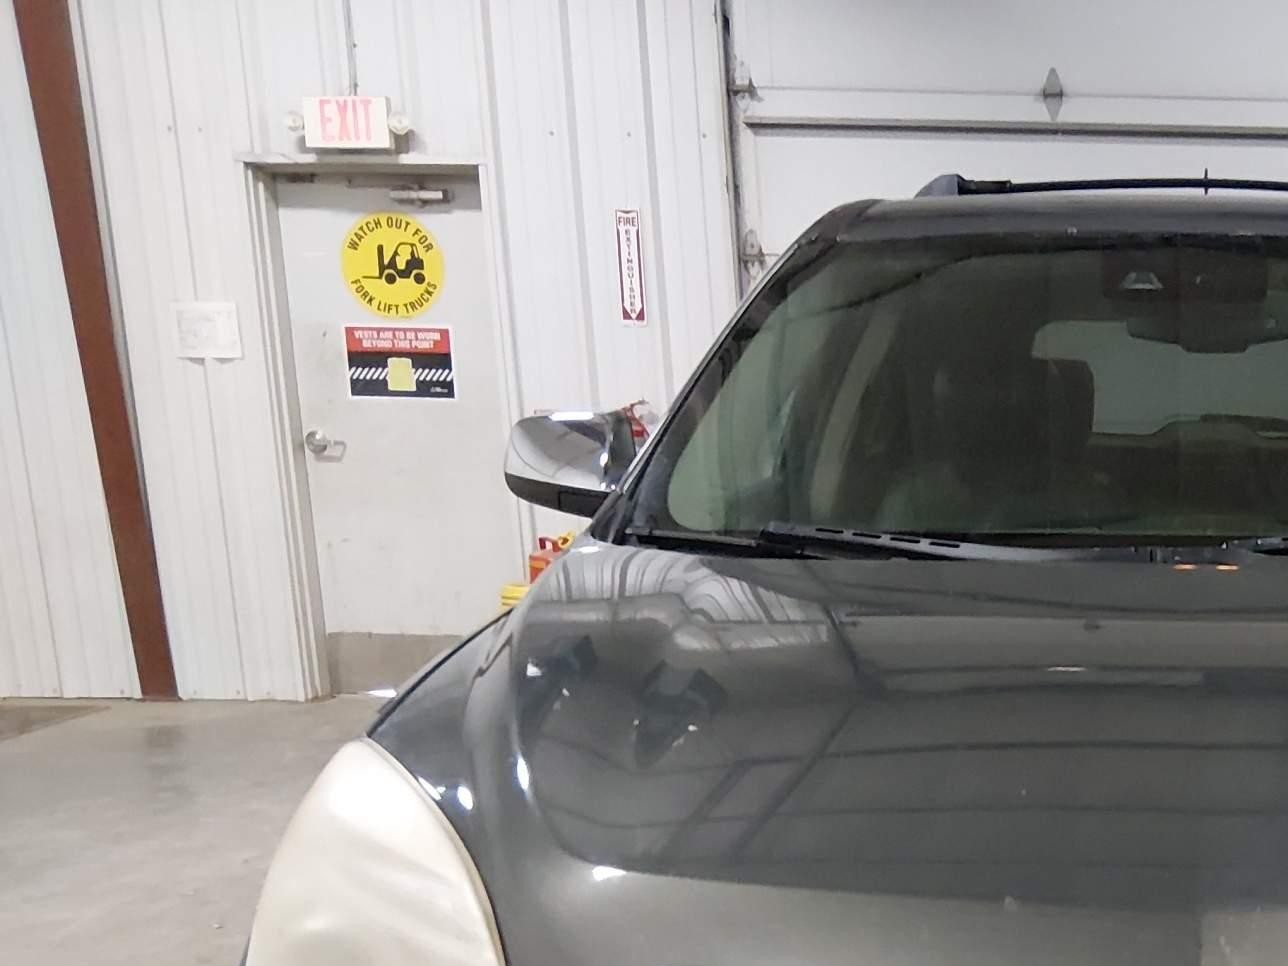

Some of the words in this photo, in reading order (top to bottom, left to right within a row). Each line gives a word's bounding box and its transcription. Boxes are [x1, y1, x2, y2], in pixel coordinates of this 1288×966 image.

[319, 99, 372, 141] EXIT
[347, 217, 383, 251] WATCH
[386, 216, 411, 232] OUT
[411, 228, 434, 253] FOR
[617, 216, 636, 227] FIRE
[625, 228, 636, 314] EXTINGUISHER
[351, 279, 376, 307] FORK
[377, 300, 400, 315] LIFT
[403, 281, 437, 315] TRUCKS
[379, 330, 394, 340] ARE
[394, 331, 404, 340] TO
[394, 340, 411, 349] THIS
[411, 340, 434, 349] POINT
